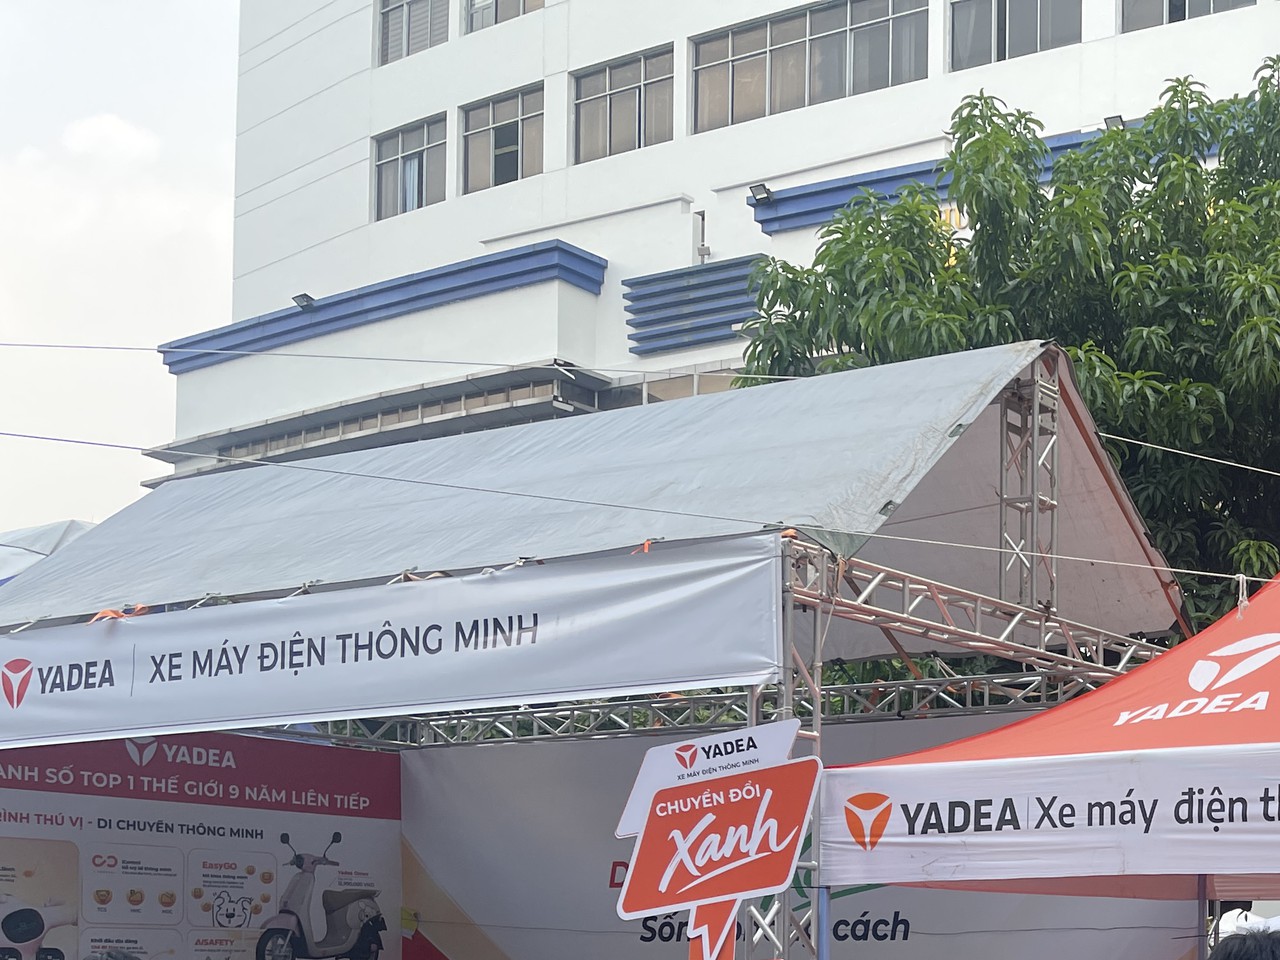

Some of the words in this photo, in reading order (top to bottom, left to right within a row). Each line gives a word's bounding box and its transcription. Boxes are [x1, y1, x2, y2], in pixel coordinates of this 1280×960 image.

[37, 659, 115, 694] YADEA
[149, 652, 182, 684] XE
[192, 639, 250, 678] MÁY
[257, 631, 326, 676] ĐIỆN
[336, 620, 443, 663] THÔNG
[455, 613, 539, 652] MINH
[1112, 691, 1269, 726] YADEA
[162, 743, 236, 769] YADEA
[701, 736, 758, 760] YADEA
[45, 764, 74, 785] SỐ
[80, 771, 122, 788] TOP
[127, 775, 135, 790] 1
[140, 774, 180, 794] THẾ
[184, 779, 223, 798] GIỚI
[229, 785, 240, 798] 9
[245, 784, 286, 803] NĂM
[292, 789, 329, 807] LIÊN
[334, 792, 370, 810] TIẾP
[676, 773, 685, 781] XE
[686, 770, 701, 779] MÁY
[701, 766, 717, 775] ĐIỆN
[718, 763, 741, 772] THÔNG
[741, 758, 760, 766] MINH
[655, 789, 725, 817] CHUYỂN
[729, 780, 761, 803] ĐỔI
[900, 797, 1021, 835] YADEA
[1035, 796, 1076, 830] Xe
[1087, 789, 1157, 834] máy
[1174, 788, 1247, 832] điện
[0, 808, 30, 824] ÌNH
[34, 812, 65, 826] THÚ
[69, 815, 83, 831] VỊ
[97, 818, 112, 830] DI
[178, 822, 226, 838] THÔNG
[230, 827, 264, 840] MINH
[658, 789, 799, 893] Xanh
[833, 911, 910, 941] cách
